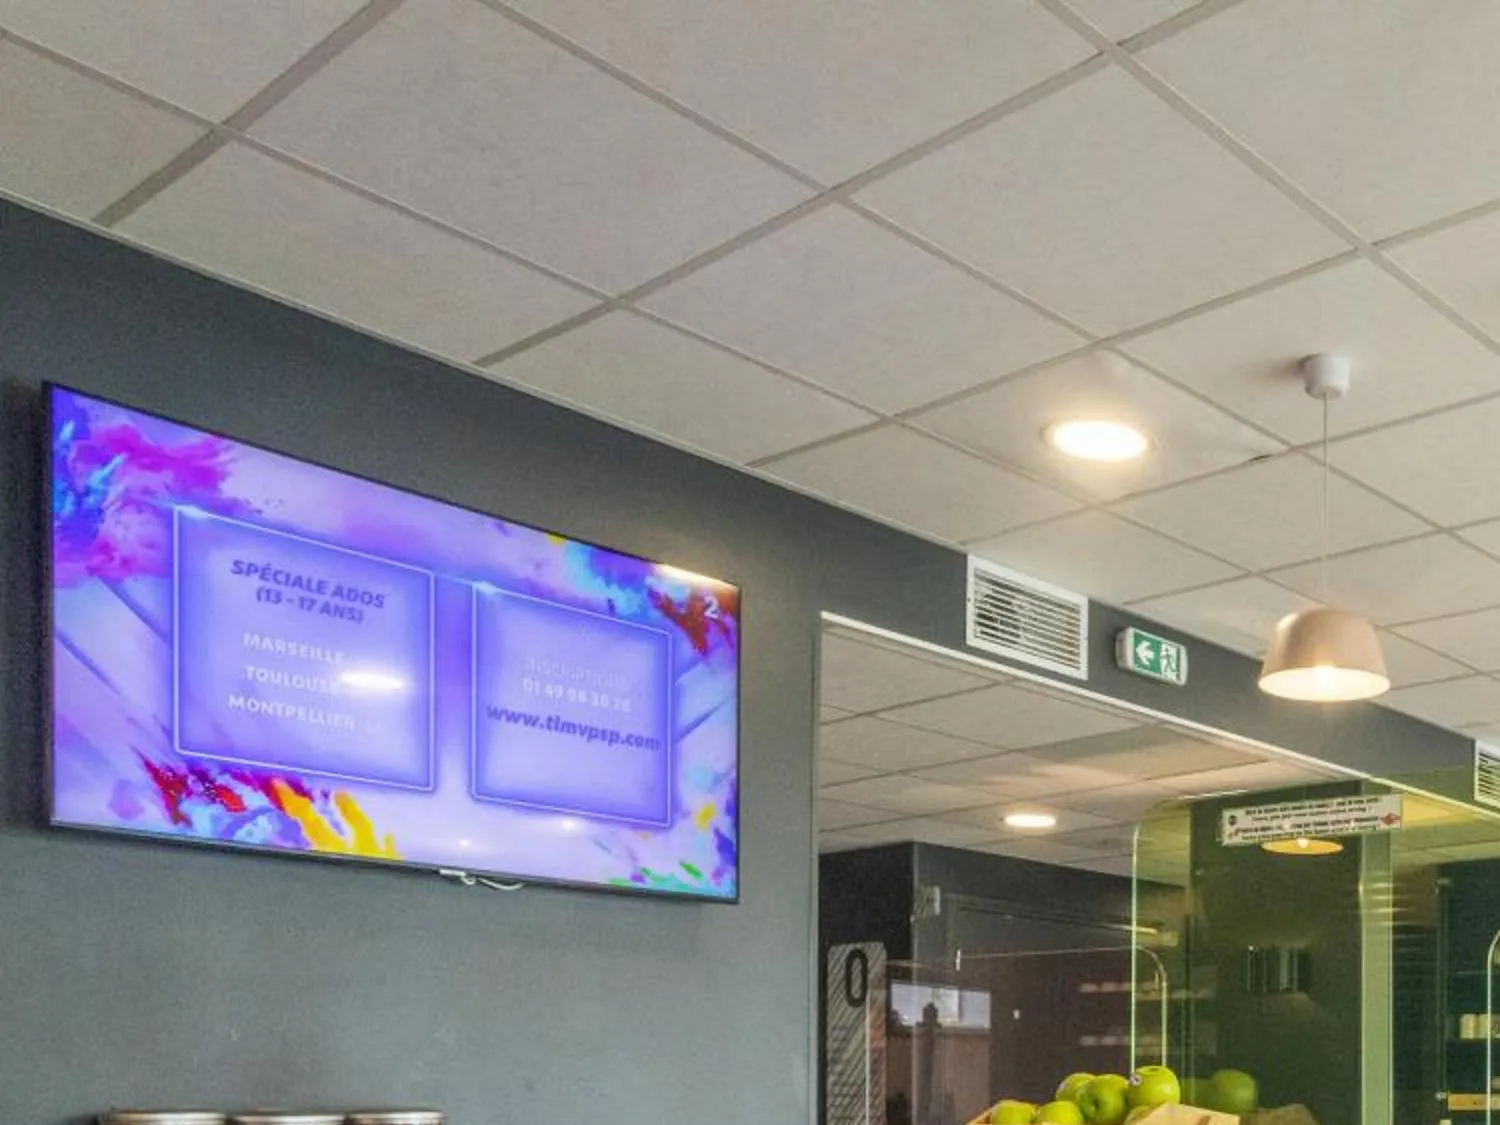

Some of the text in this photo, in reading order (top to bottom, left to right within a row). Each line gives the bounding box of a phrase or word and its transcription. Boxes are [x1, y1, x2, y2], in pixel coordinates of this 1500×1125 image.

[230, 559, 386, 609] SPÉCIALE ADOS
[256, 586, 283, 605] (13
[298, 595, 317, 612] 17
[319, 600, 364, 624] ANS)
[704, 597, 719, 619] 2
[243, 632, 345, 664] MARSEILLE
[228, 694, 355, 729] MONTPELLIER
[486, 704, 661, 751] www.tlmvpsp.com
